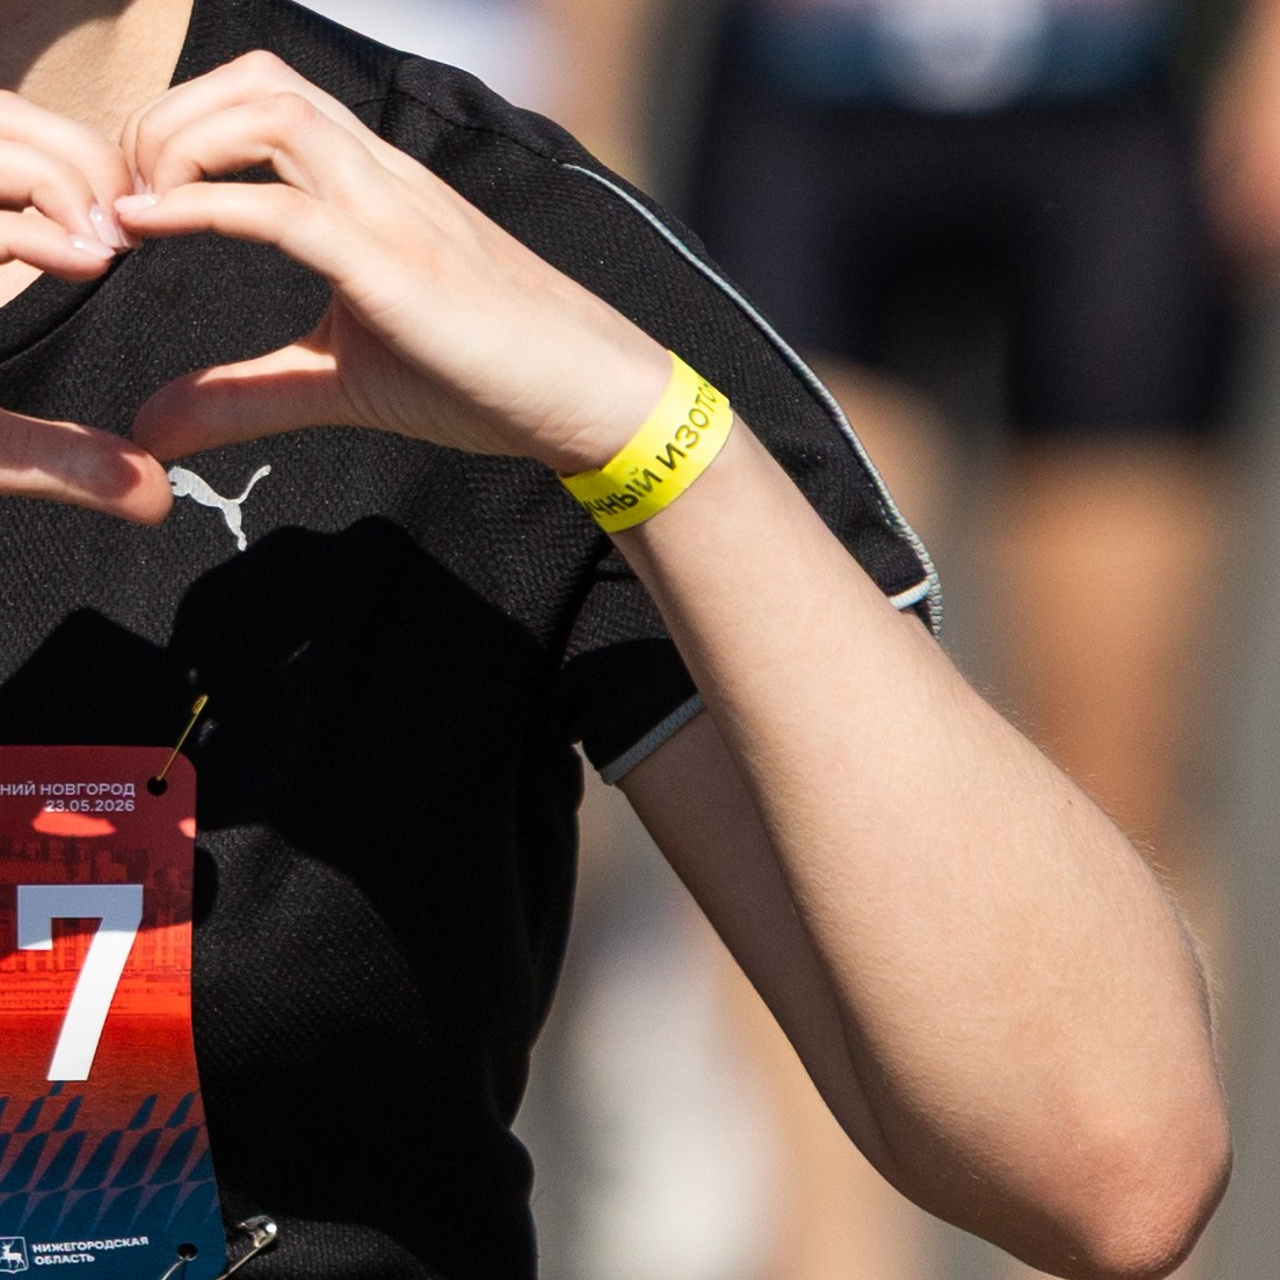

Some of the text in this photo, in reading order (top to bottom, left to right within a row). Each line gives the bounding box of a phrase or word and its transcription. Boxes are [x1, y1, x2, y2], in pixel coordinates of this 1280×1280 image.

[656, 383, 718, 471] ИЗОТО
[39, 783, 136, 798] НОВГОРОД
[45, 799, 136, 813] 23.05.2026
[32, 1236, 149, 1254] НИЖЕГОРОДСКАЯ
[34, 1253, 96, 1266] ОБЛАСТЬ
